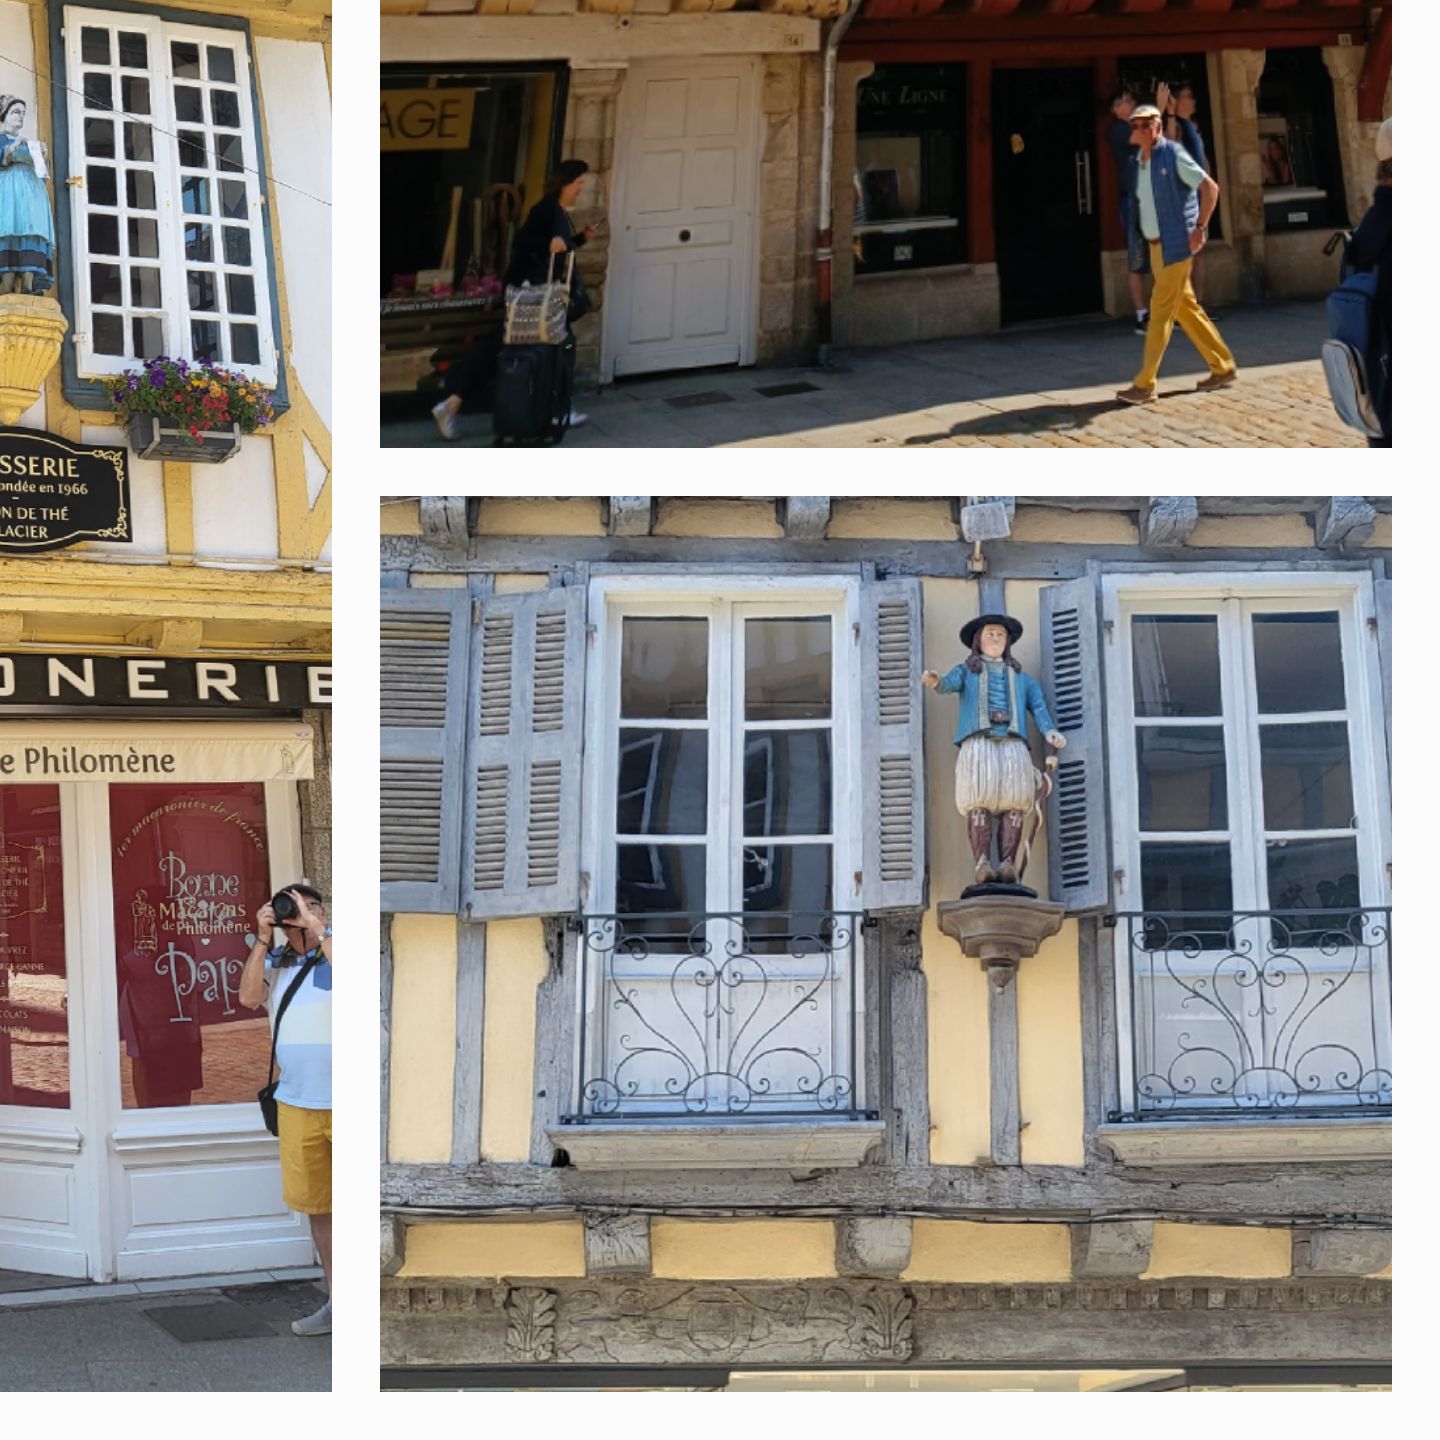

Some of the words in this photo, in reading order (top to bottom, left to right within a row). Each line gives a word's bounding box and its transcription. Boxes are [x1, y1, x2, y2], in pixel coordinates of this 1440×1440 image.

[39, 484, 54, 493] en
[58, 483, 88, 495] 1966
[17, 507, 37, 521] DE
[40, 505, 70, 521] THÉ
[25, 746, 176, 774] Philomène
[132, 797, 207, 835] macaronier
[210, 801, 226, 816] de
[159, 851, 240, 899] Bonne
[162, 920, 175, 930] de
